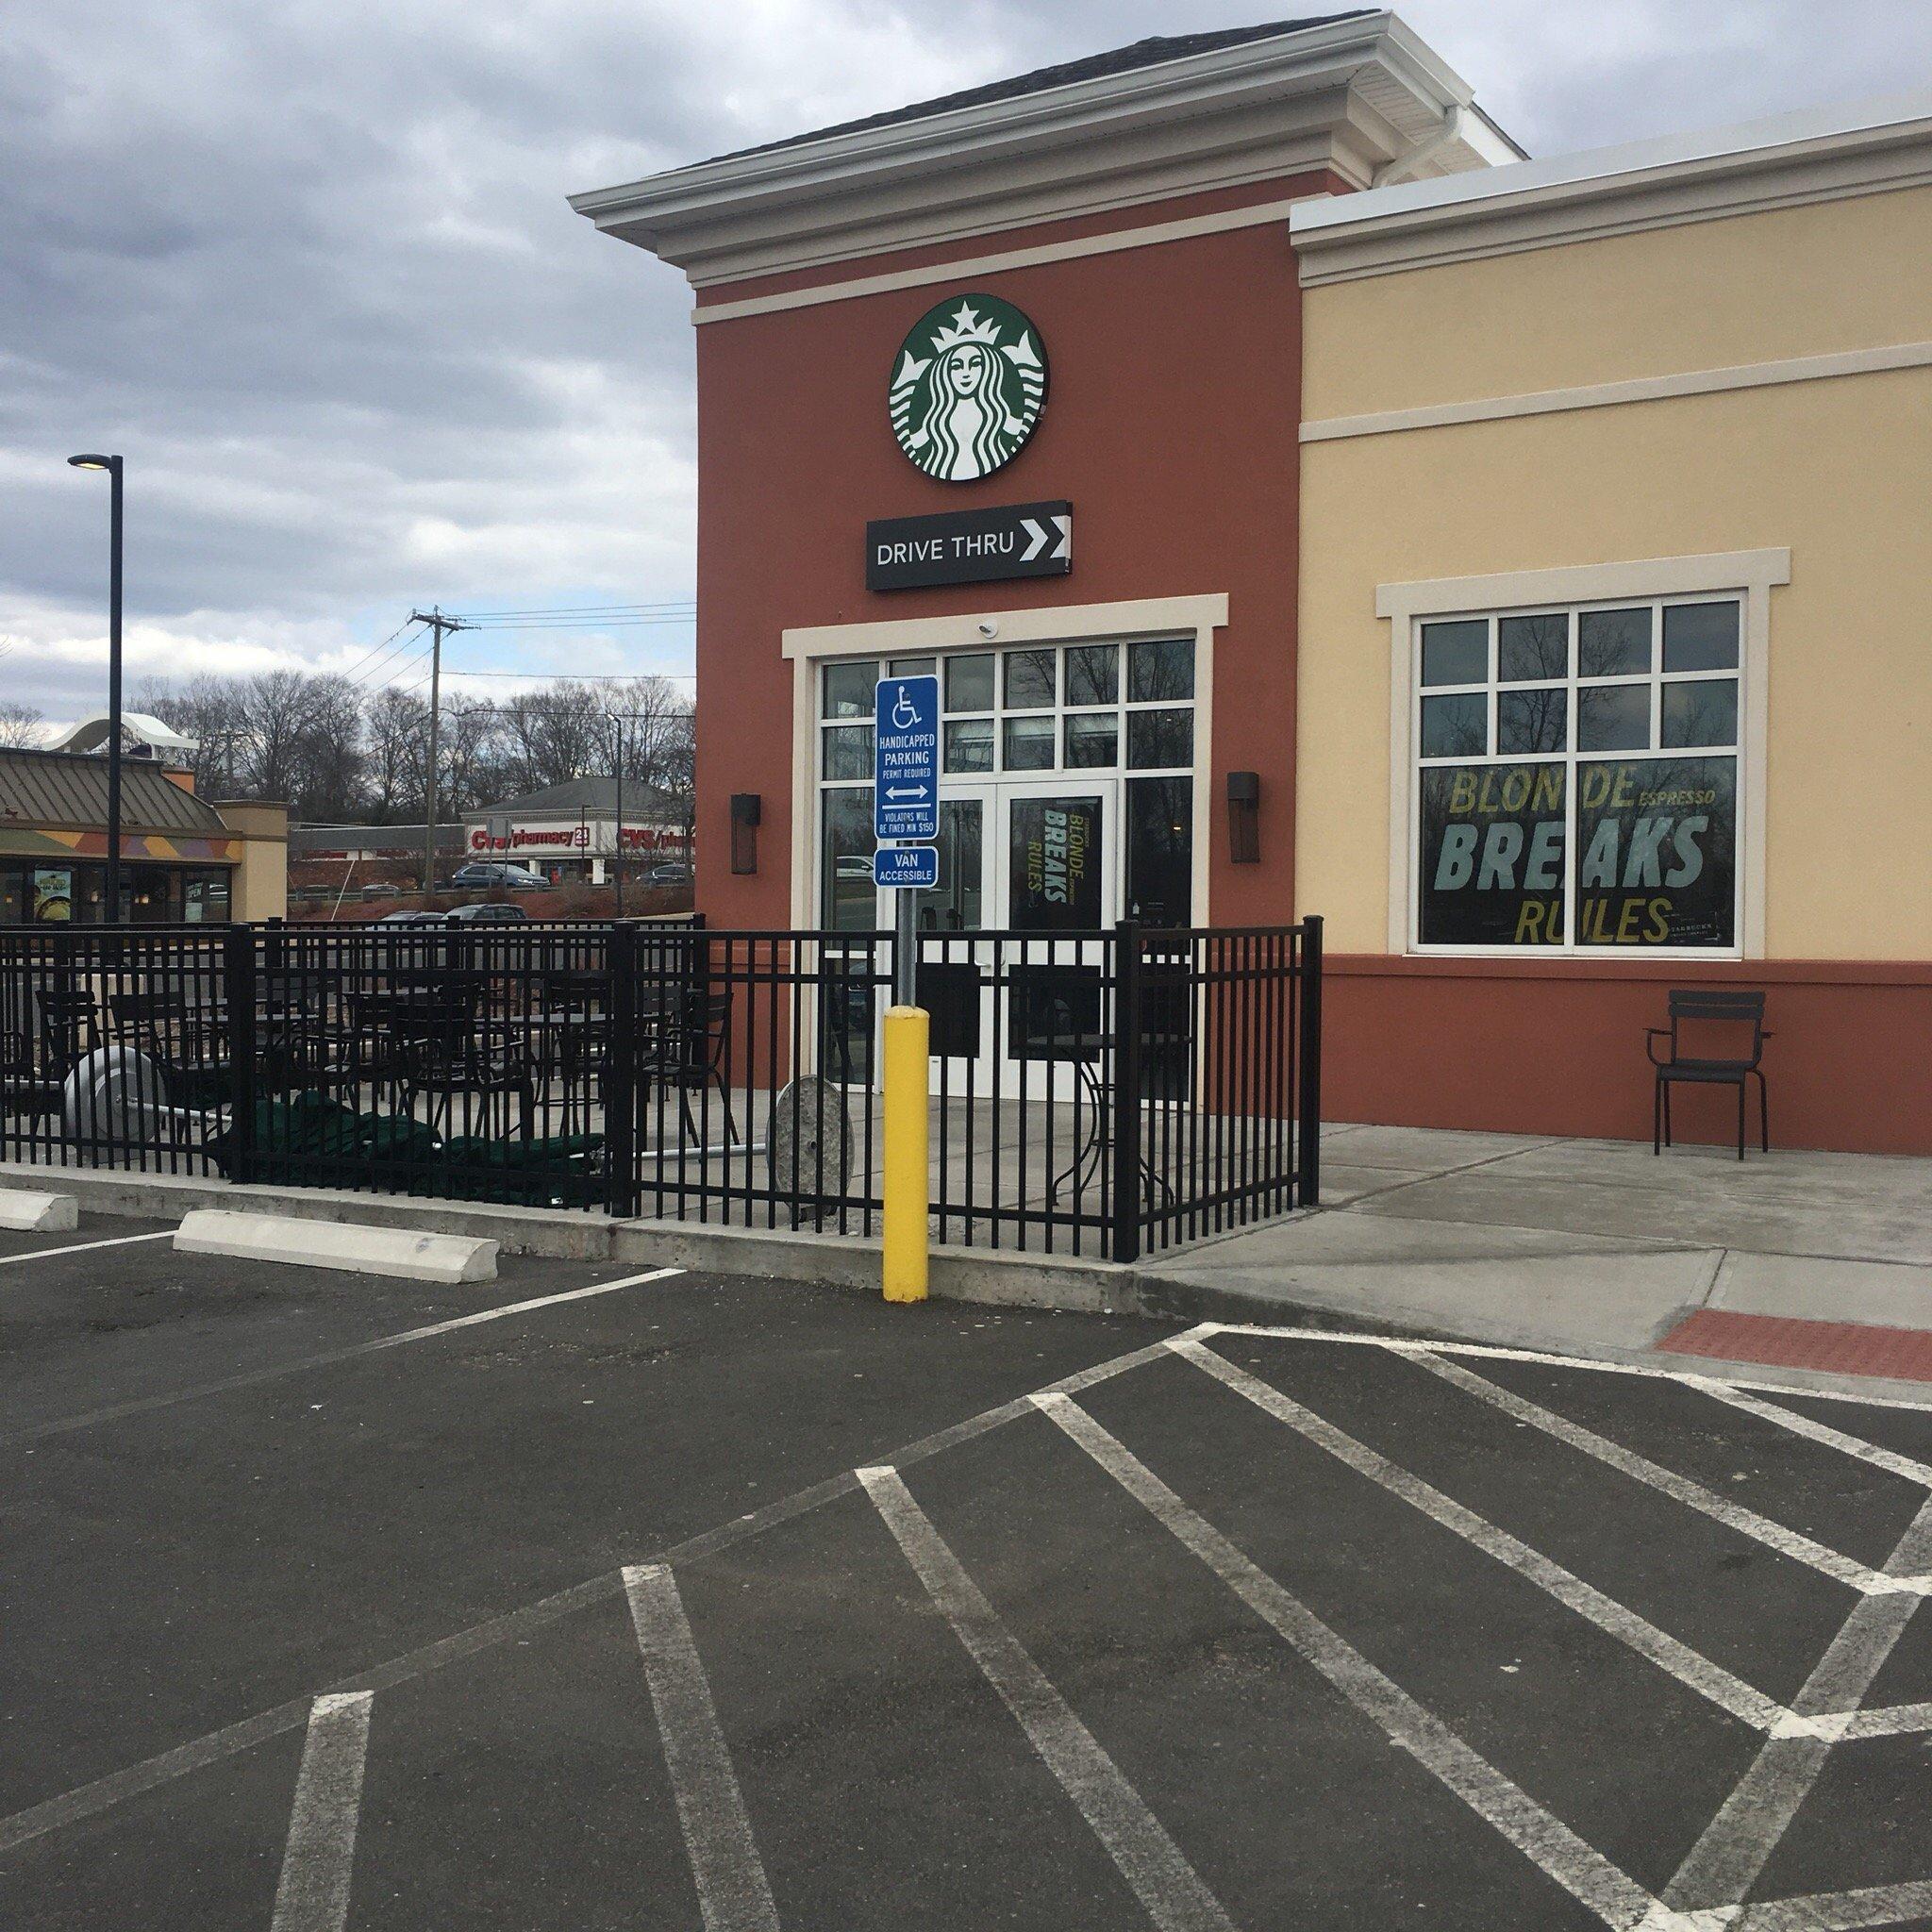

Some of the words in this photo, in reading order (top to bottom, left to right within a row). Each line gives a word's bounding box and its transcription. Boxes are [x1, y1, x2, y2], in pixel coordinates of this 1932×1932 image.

[876, 539, 943, 566] DRIVE
[951, 531, 1015, 558] THRU
[879, 734, 934, 749] HANDICAPPED
[885, 751, 929, 766] PARKING
[882, 769, 903, 779] PERMIT
[904, 768, 931, 778] REQUIRED
[1449, 763, 1637, 814] BLONDE
[1640, 789, 1716, 807] ESPRESSO
[884, 813, 915, 823] VIOLATORS
[916, 812, 928, 822] WILL
[879, 824, 887, 834] BE
[889, 824, 905, 833] FINED
[908, 823, 918, 833] MIN
[919, 822, 934, 832] $150
[1070, 813, 1084, 879] BLONDE
[1434, 816, 1708, 891] BREAKS
[894, 854, 919, 867] VAN
[1028, 841, 1042, 891] RULES
[1044, 810, 1067, 904] BREAKS
[879, 871, 932, 881] ACCESSIBLE
[1514, 898, 1673, 943] RULES
